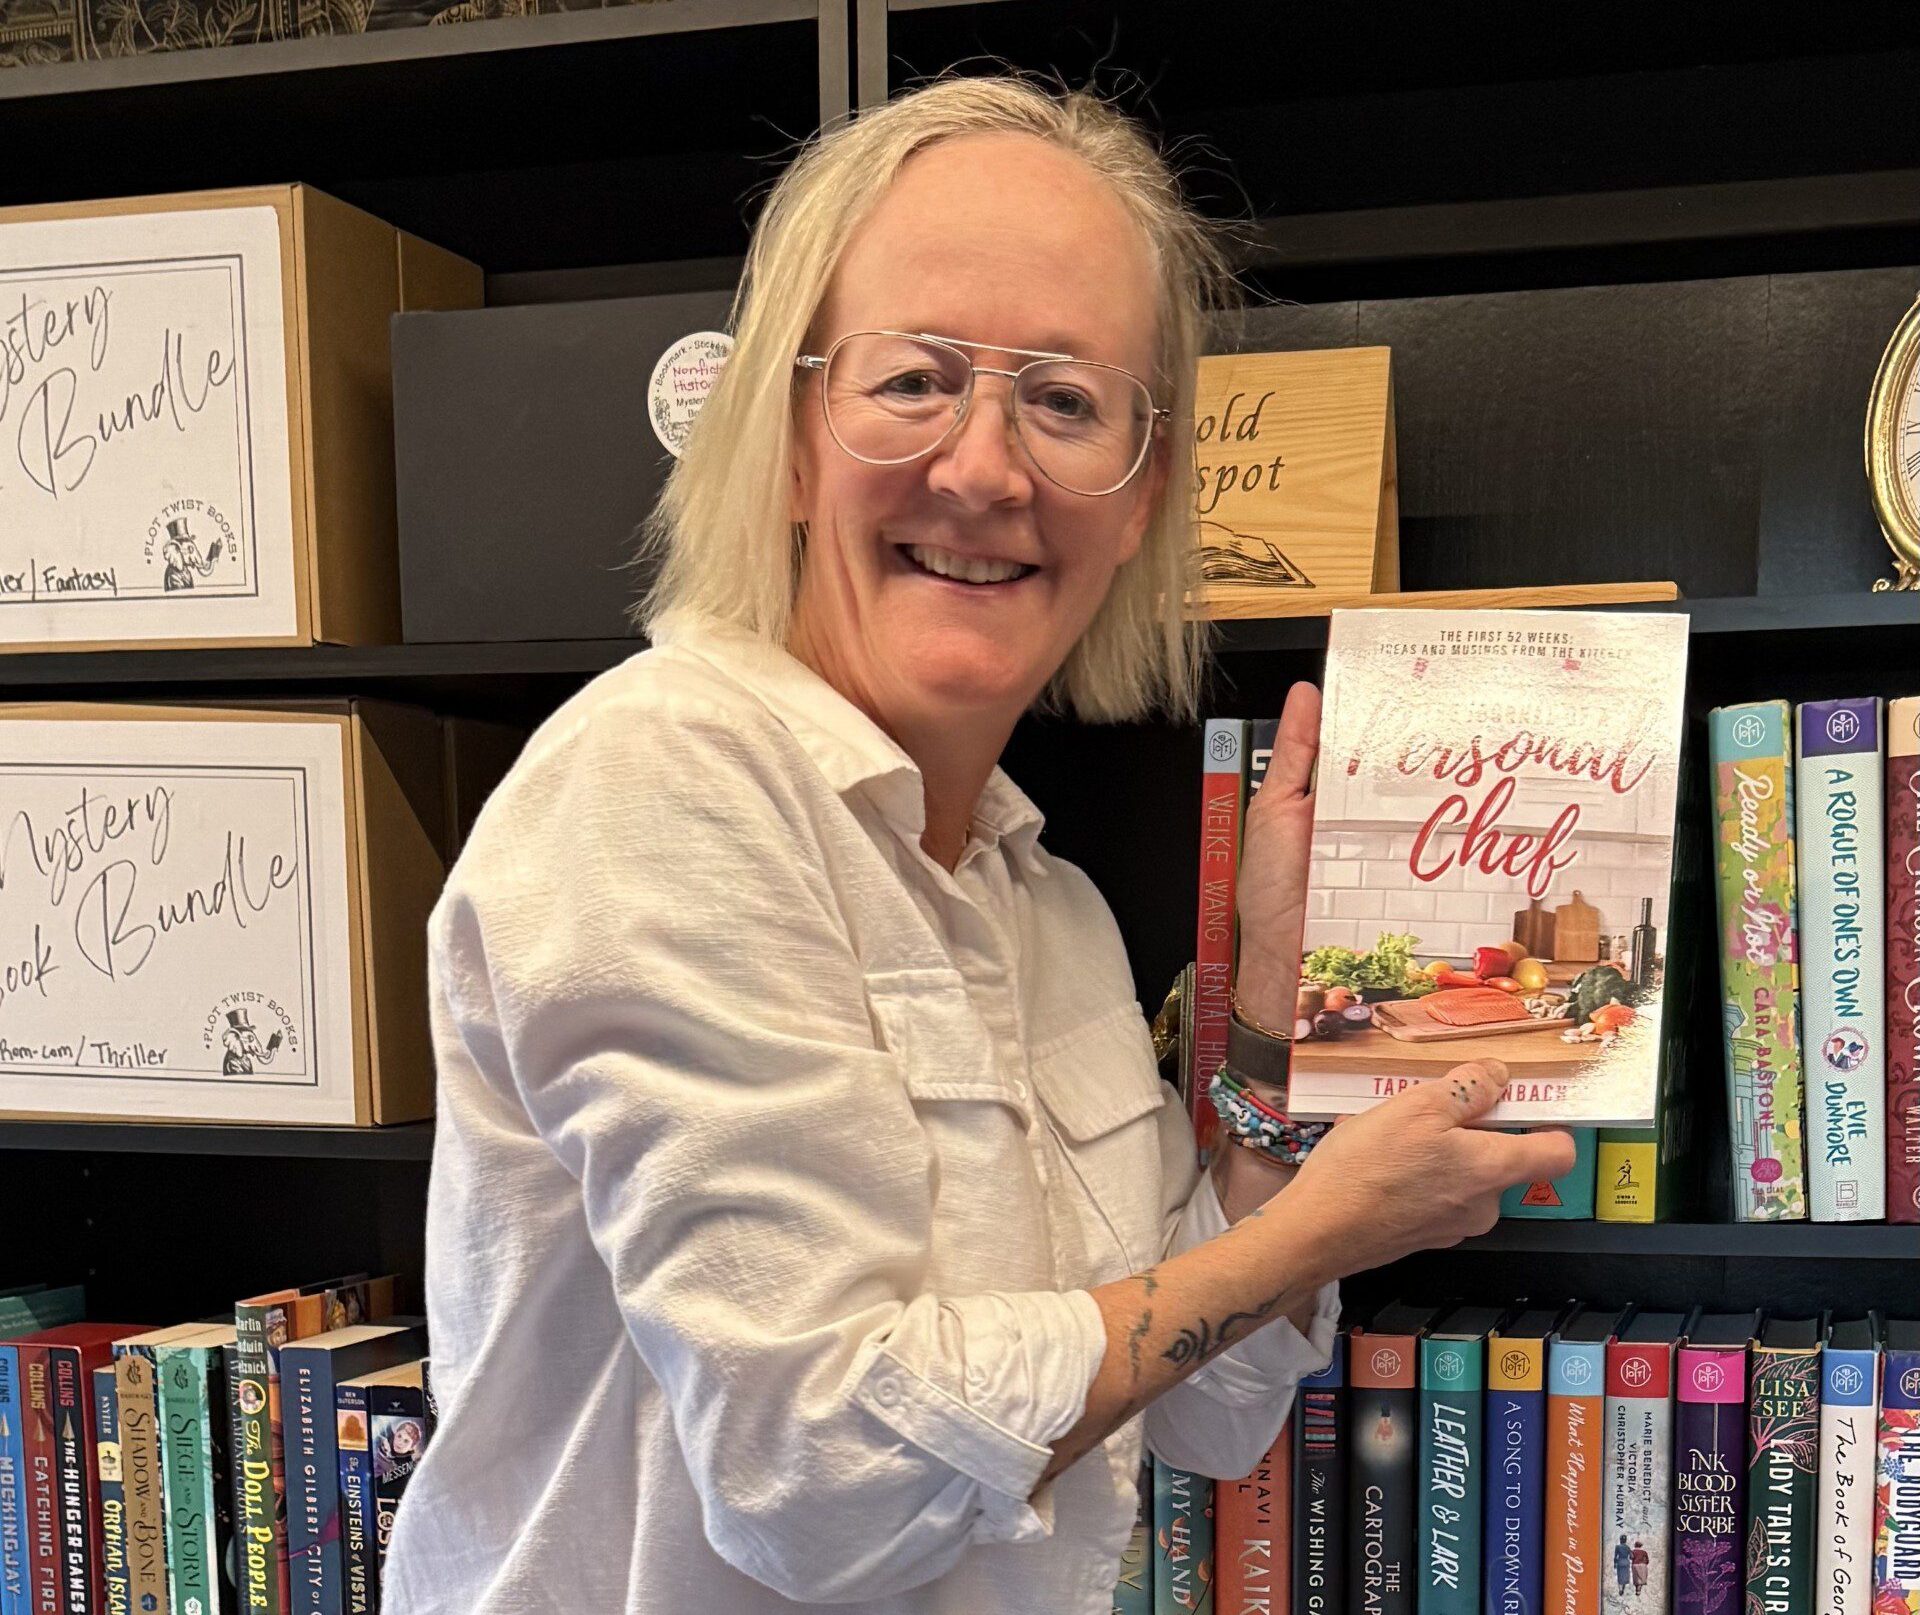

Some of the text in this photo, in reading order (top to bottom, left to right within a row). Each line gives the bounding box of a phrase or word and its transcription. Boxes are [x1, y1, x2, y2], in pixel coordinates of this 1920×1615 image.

[0, 286, 113, 422] stery
[18, 327, 235, 500] Bundle
[1198, 456, 1285, 515] spot
[144, 499, 238, 557] PLOT TWIST BOOKS
[43, 566, 117, 596] Fantasy
[1379, 644, 1416, 655] IDEAS
[1422, 644, 1445, 655] AND
[1450, 645, 1507, 656] MUSINGS
[1512, 646, 1545, 657] FROM
[1551, 647, 1574, 659] THE
[1440, 630, 1573, 644] THE FIRST 52 WEEKS:
[0, 786, 174, 906] Mystery
[1205, 792, 1234, 864] WEIKE
[1409, 776, 1580, 898] Chef
[1733, 767, 1775, 966] Ready or Not
[1825, 769, 1863, 1018] A ROGUE OF ONE'S OWN
[0, 831, 298, 1002] ook Bundle
[1205, 879, 1231, 943] WANG
[204, 991, 298, 1046] PLOT TWIST BOOKS
[1200, 963, 1232, 1031] RENTAL
[90, 1041, 168, 1069] Thriller
[1374, 1077, 1420, 1096] TAR
[1753, 986, 1775, 1131] CARA BASTONE
[1825, 1081, 1853, 1168] DUNMORE
[1845, 1101, 1868, 1139] EVIE
[298, 1367, 315, 1455] ELIZABETH
[1504, 1401, 1522, 1415] A
[1759, 1379, 1810, 1398] LISA
[1762, 1400, 1806, 1418] SEE
[124, 1408, 151, 1499] SHADOW
[170, 1413, 198, 1482] SIEGE
[249, 1420, 262, 1455] The
[1503, 1419, 1522, 1475] SONG
[1567, 1401, 1587, 1448] What
[1643, 1411, 1652, 1445] MARIE
[29, 1362, 56, 1614] COLLINS CATCHING FIRE
[57, 1360, 86, 1615] COLLINS THE HUNGER GAMES
[244, 1460, 270, 1519] DOLL
[304, 1464, 320, 1534] GILBERT
[1310, 1468, 1326, 1494] The
[1431, 1402, 1470, 1590] LEATHER & LARK
[1505, 1483, 1521, 1509] TO
[1560, 1450, 1586, 1536] Happens
[1615, 1405, 1626, 1529] CHRISTOPHER MURRAY
[1627, 1442, 1636, 1494] VICTORIA
[1643, 1450, 1652, 1503] BENEDICT
[1678, 1473, 1737, 1492] BLOOD
[1768, 1438, 1795, 1496] LADY
[1, 1457, 21, 1594] MOCKINGJAY
[103, 1500, 123, 1573] ORPHAN
[346, 1475, 364, 1551] EINSTEINS
[1172, 1473, 1191, 1605] MY HAND
[1309, 1499, 1325, 1587] WISHING
[1568, 1537, 1578, 1550] in
[1767, 1503, 1793, 1568] TAN'S
[1831, 1417, 1857, 1615] The Book of Geor
[133, 1519, 158, 1583] BONE
[174, 1508, 202, 1587] STORM
[247, 1526, 273, 1608] PEOPLE
[307, 1545, 323, 1588] CITY
[1385, 1561, 1400, 1593] THE
[1503, 1517, 1521, 1594] DROWN
[350, 1565, 366, 1614] VISTA
